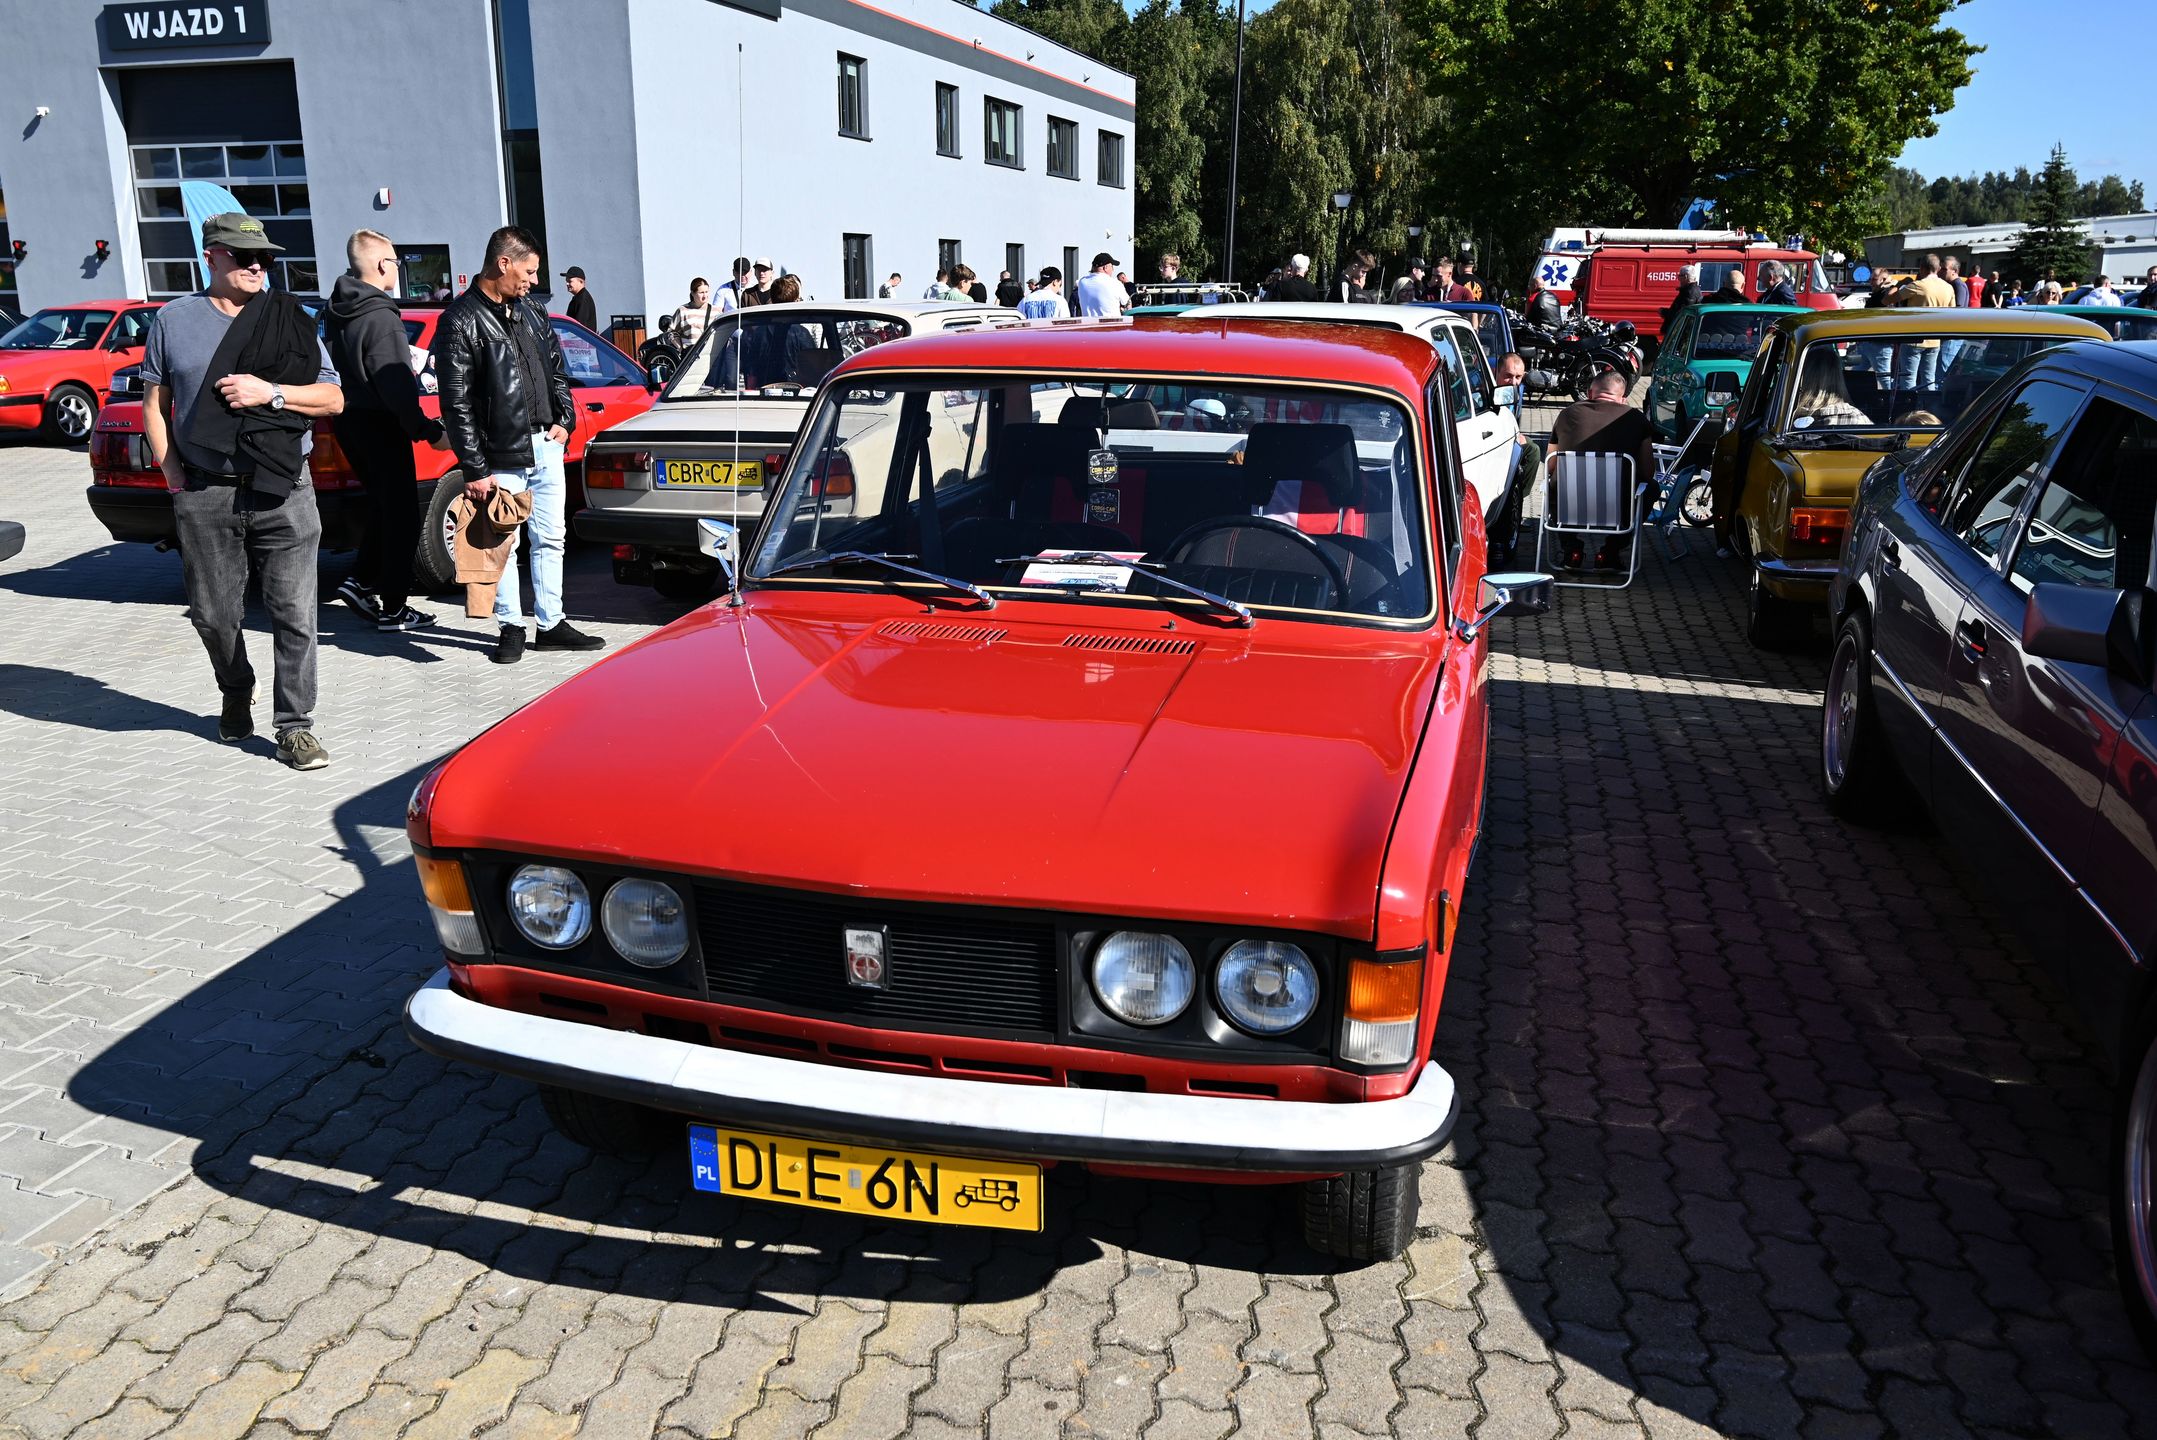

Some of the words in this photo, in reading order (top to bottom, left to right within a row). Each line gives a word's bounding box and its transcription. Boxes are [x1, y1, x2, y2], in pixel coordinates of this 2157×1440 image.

[124, 8, 224, 39] WJAZD
[234, 6, 247, 33] 1
[668, 463, 704, 483] CBR
[710, 464, 733, 484] C7
[697, 1164, 716, 1181] PL
[728, 1137, 842, 1204] DLE
[866, 1157, 939, 1215] 6N
